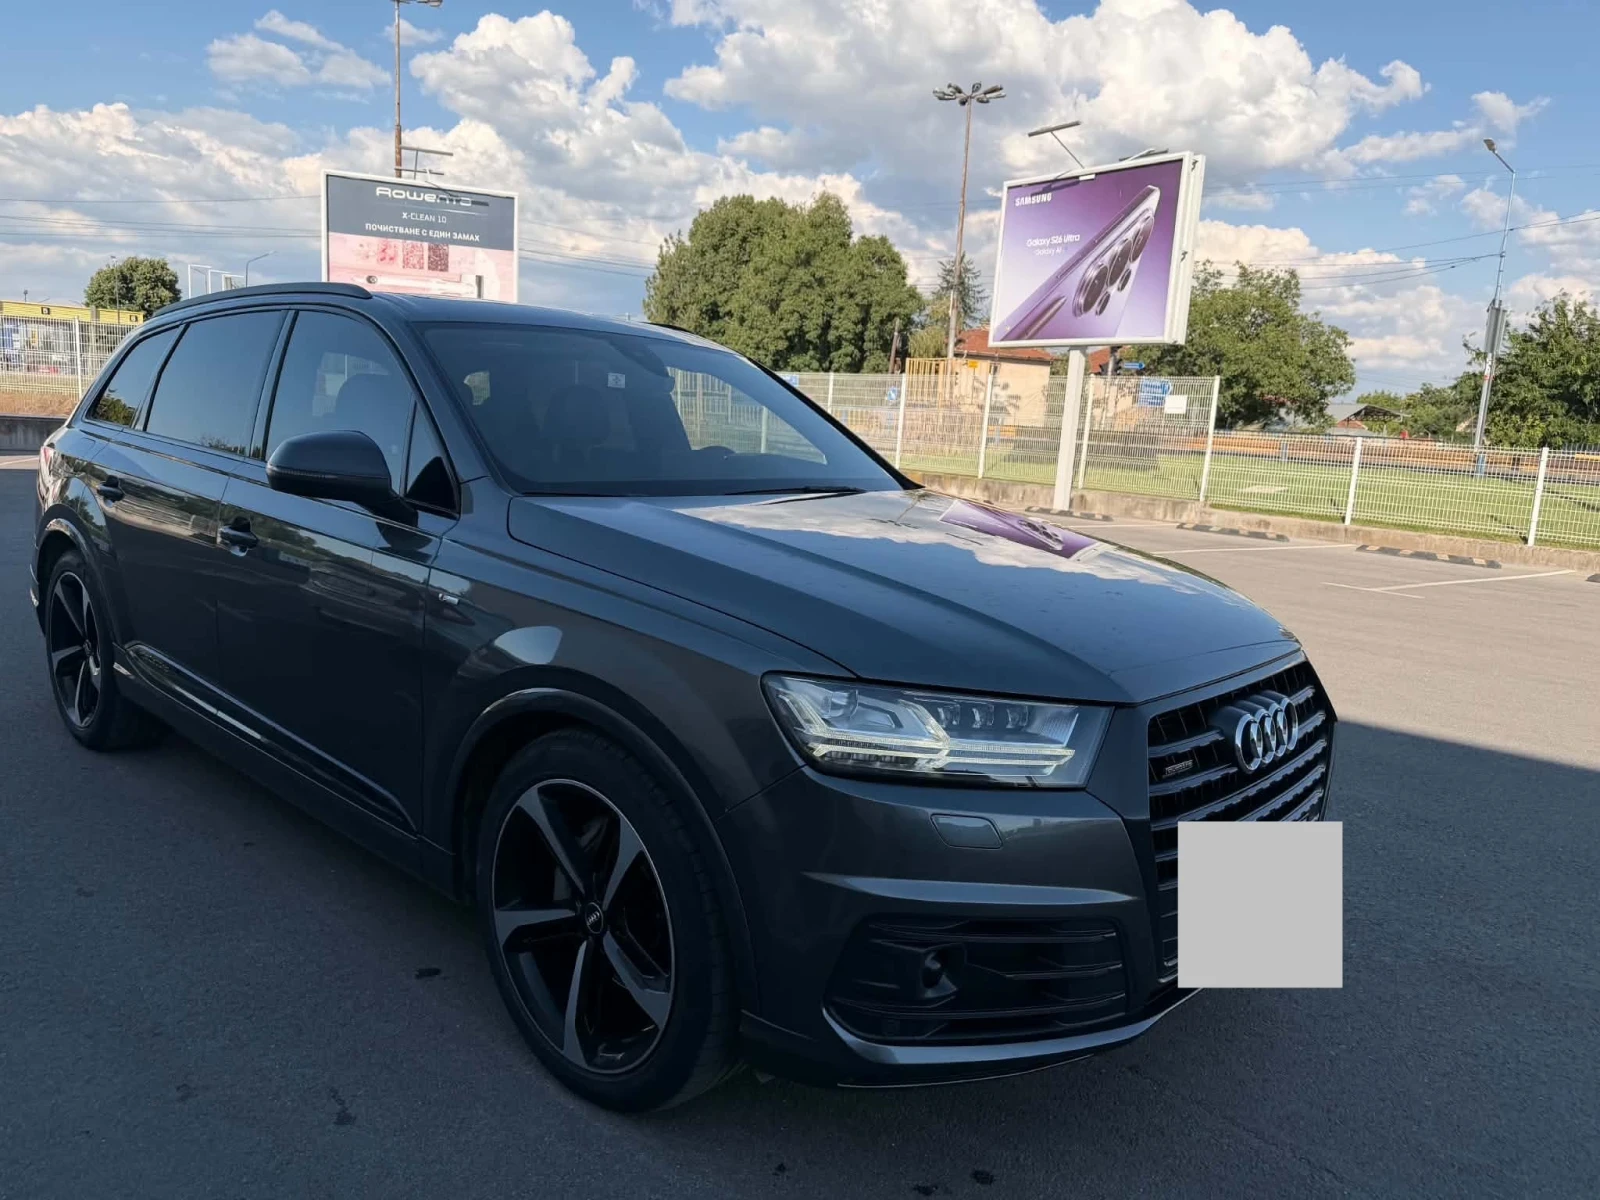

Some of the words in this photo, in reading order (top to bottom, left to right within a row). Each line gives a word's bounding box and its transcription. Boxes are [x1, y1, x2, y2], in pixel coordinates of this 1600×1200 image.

[1014, 192, 1052, 207] SAMSUNG
[402, 211, 436, 222] X-CLEAN
[438, 215, 447, 224] 10
[364, 223, 421, 236] ПОЧИСТВАНЕ
[421, 228, 428, 237] С
[428, 229, 451, 239] ЕДИН
[452, 231, 480, 242] ЗАМАХ
[1026, 237, 1050, 247] Galaxy
